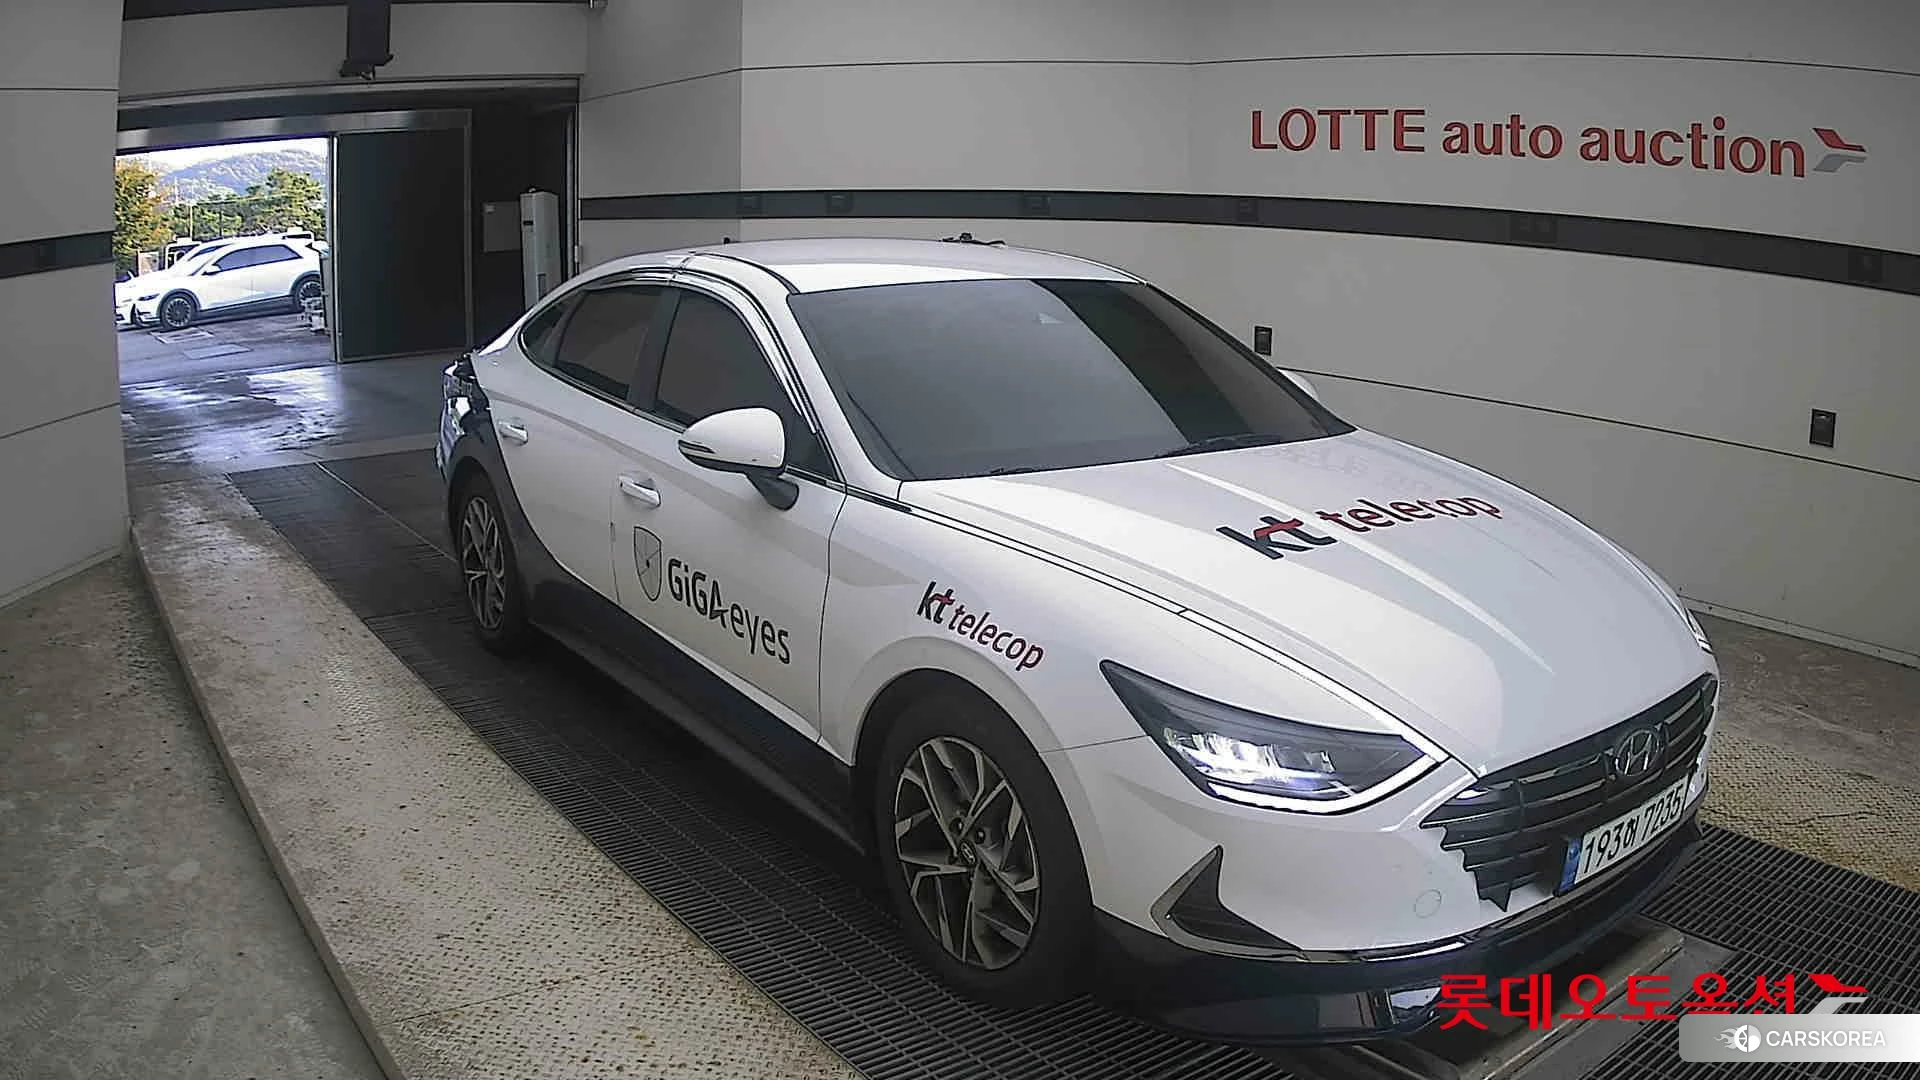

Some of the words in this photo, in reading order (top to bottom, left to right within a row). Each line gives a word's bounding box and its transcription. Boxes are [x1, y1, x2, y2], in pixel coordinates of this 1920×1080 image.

[1251, 109, 1426, 152] LOTTE
[1442, 114, 1563, 158] auto
[1579, 117, 1807, 178] auction
[1216, 516, 1338, 560] kt
[1315, 497, 1504, 532] telecop
[917, 580, 954, 625] kt
[949, 605, 1045, 671] telecop
[1642, 783, 1684, 841] 7235
